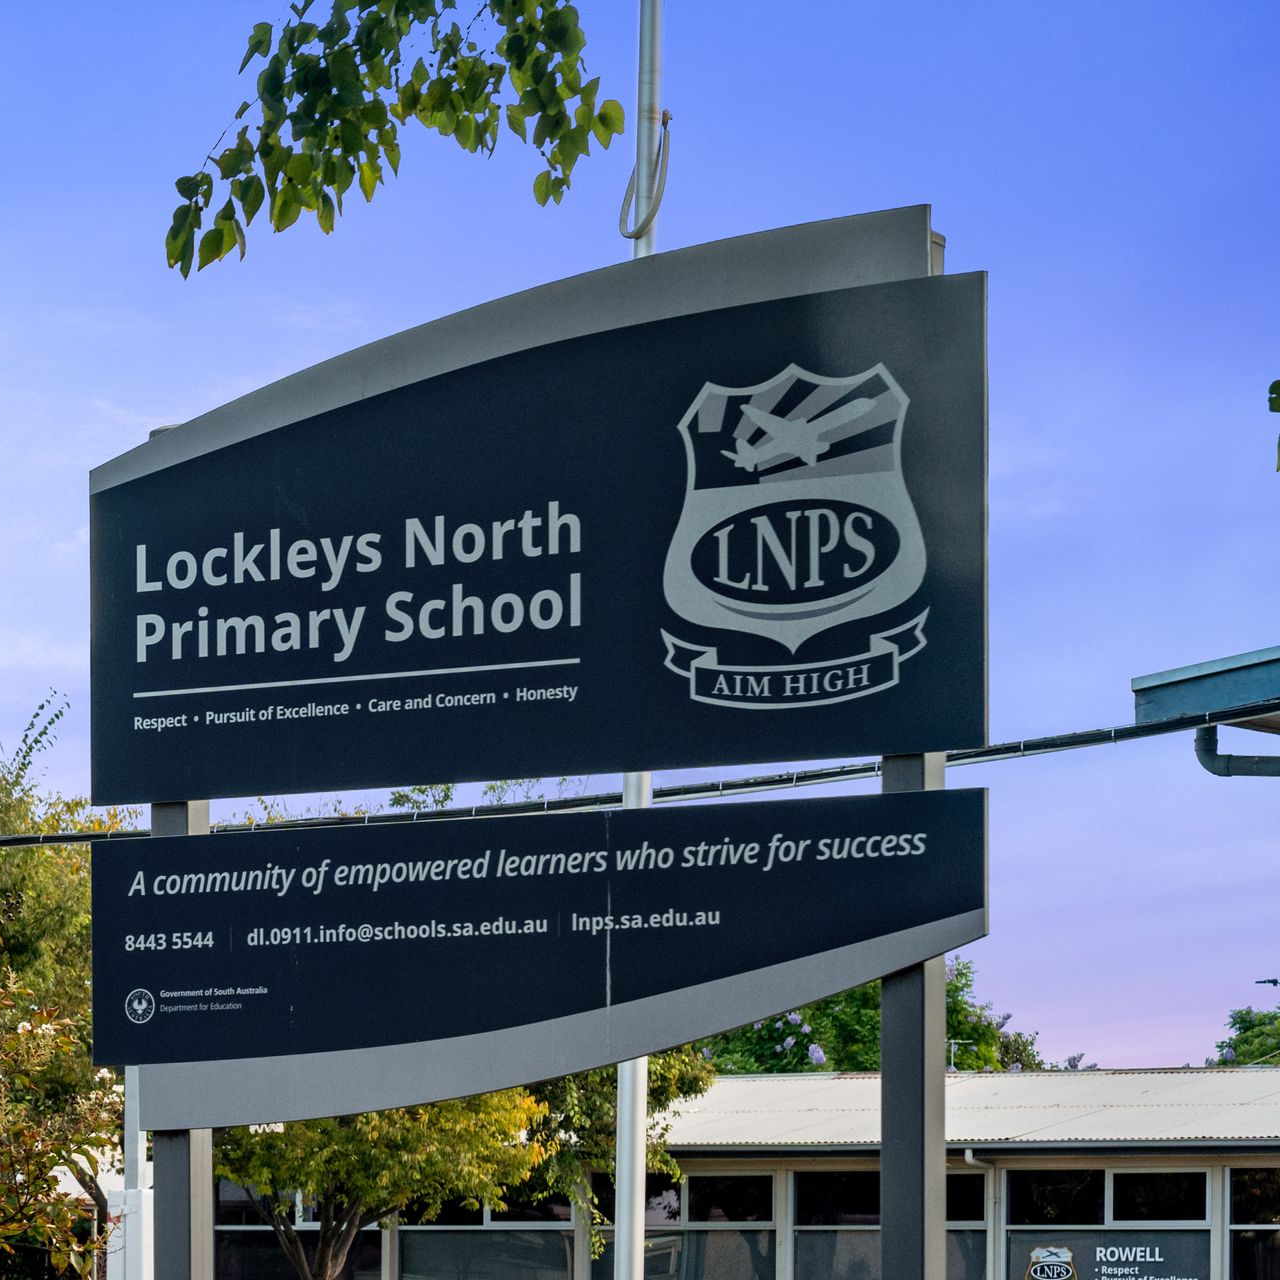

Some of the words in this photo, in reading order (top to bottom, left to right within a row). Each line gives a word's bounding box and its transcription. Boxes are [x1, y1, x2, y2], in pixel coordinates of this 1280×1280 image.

[137, 528, 382, 592] Lockleys
[405, 501, 581, 569] North
[713, 508, 876, 591] LNPS
[137, 606, 366, 662] Primary
[385, 573, 581, 642] School
[711, 674, 771, 696] AIM
[783, 664, 871, 696] HIGH
[134, 712, 187, 732] Respect
[205, 707, 256, 725] Pursuit
[258, 706, 274, 721] of
[276, 700, 349, 719] Excellence
[368, 697, 401, 713] Care
[404, 694, 432, 710] and
[435, 690, 496, 708] Concern
[515, 684, 578, 702] Honesty
[128, 871, 146, 896] A
[153, 863, 295, 896] community
[302, 859, 330, 894] of
[334, 851, 491, 891] empowered
[496, 849, 607, 877] learners
[616, 842, 674, 870] who
[682, 837, 759, 867] strive
[762, 834, 811, 872] for
[816, 831, 926, 861] success
[247, 917, 548, 946] dl.0911.info@schools.sa.edu.au
[572, 909, 720, 935] lnps.sa.edu.au
[125, 934, 166, 951] 8443
[172, 931, 214, 949] 5544
[160, 990, 202, 998] Government
[205, 988, 213, 996] of
[214, 987, 234, 996] South
[236, 986, 267, 995] Australia
[160, 1004, 198, 1013] Department
[199, 1003, 208, 1011] for
[210, 1002, 242, 1011] Education
[1096, 1247, 1163, 1262] ROWELL
[1036, 1265, 1066, 1278] LNPS
[1101, 1266, 1139, 1276] Respect
